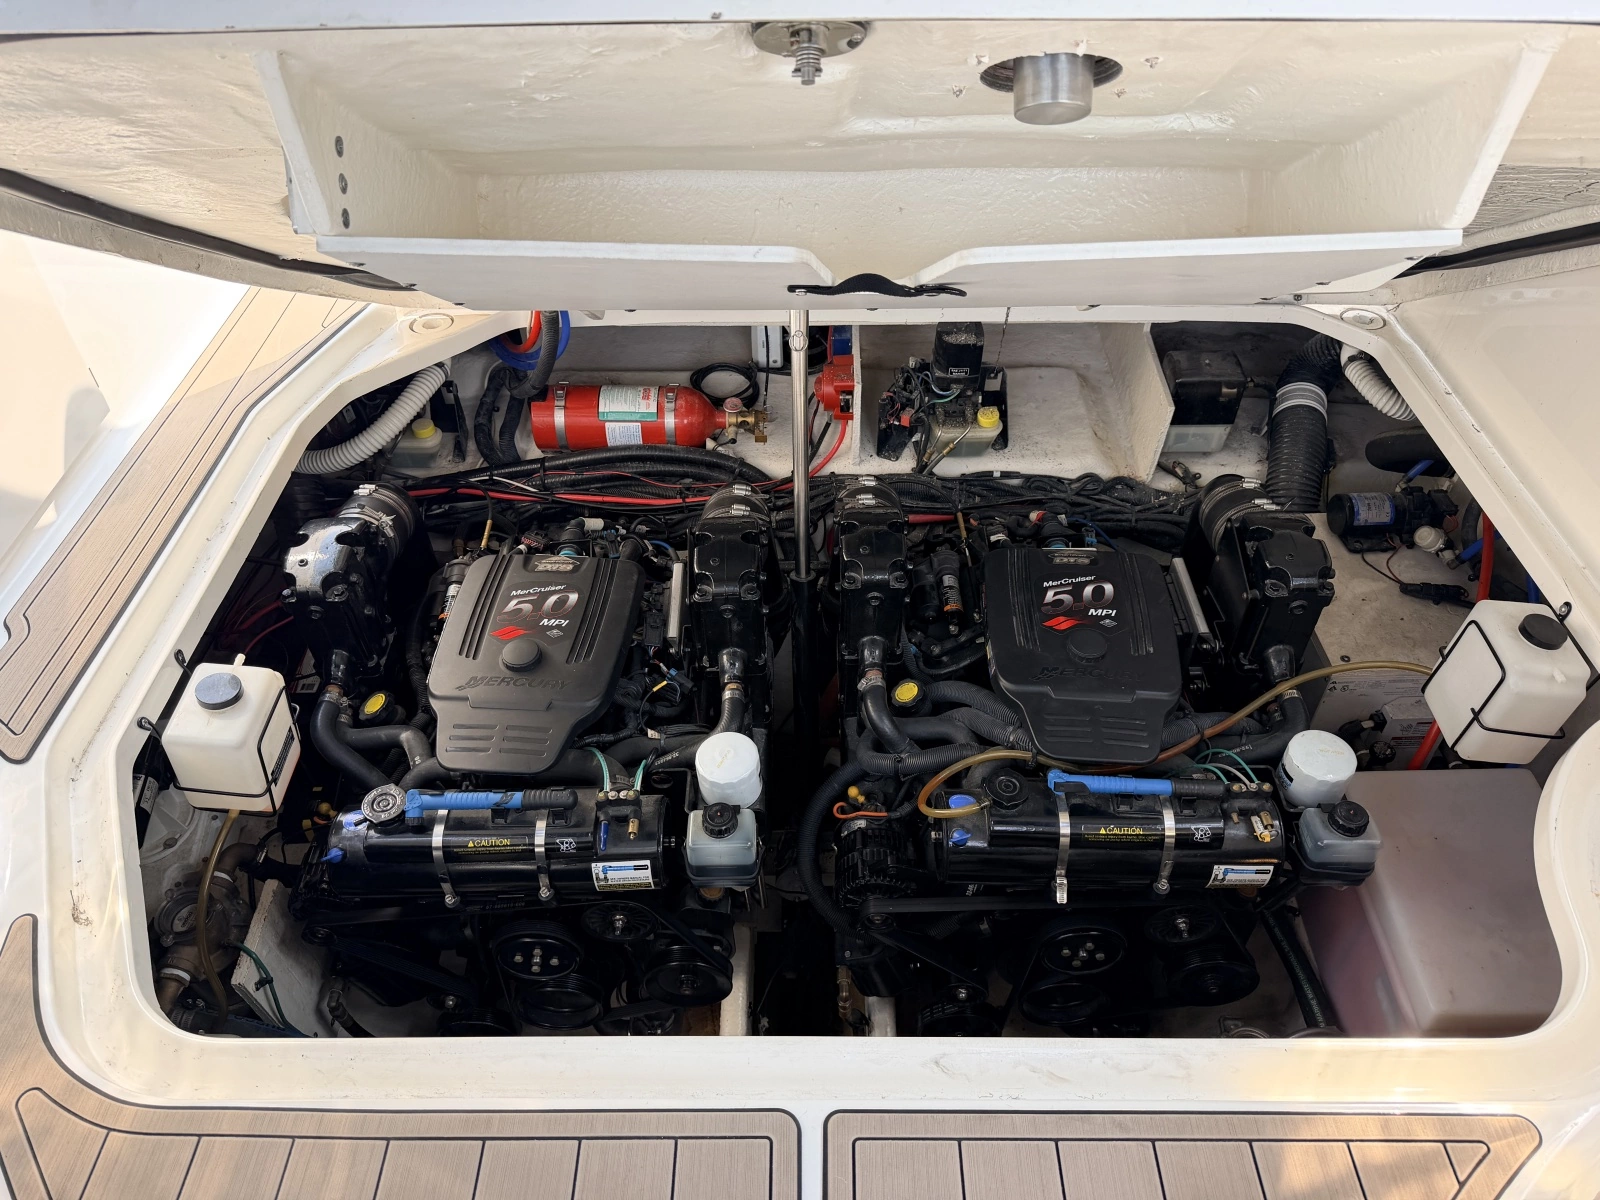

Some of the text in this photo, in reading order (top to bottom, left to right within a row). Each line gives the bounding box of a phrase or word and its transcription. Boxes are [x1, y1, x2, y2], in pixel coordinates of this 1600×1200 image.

[1043, 576, 1096, 588] MerCruiser
[510, 584, 566, 597] MerCruiser
[1041, 580, 1114, 614] 5.0
[497, 590, 579, 623] 5.0
[1088, 608, 1117, 617] MPI
[539, 618, 569, 627] MPI
[455, 676, 571, 692] MERCURY
[1107, 827, 1142, 835] CAUTION
[475, 838, 511, 847] CAUTION
